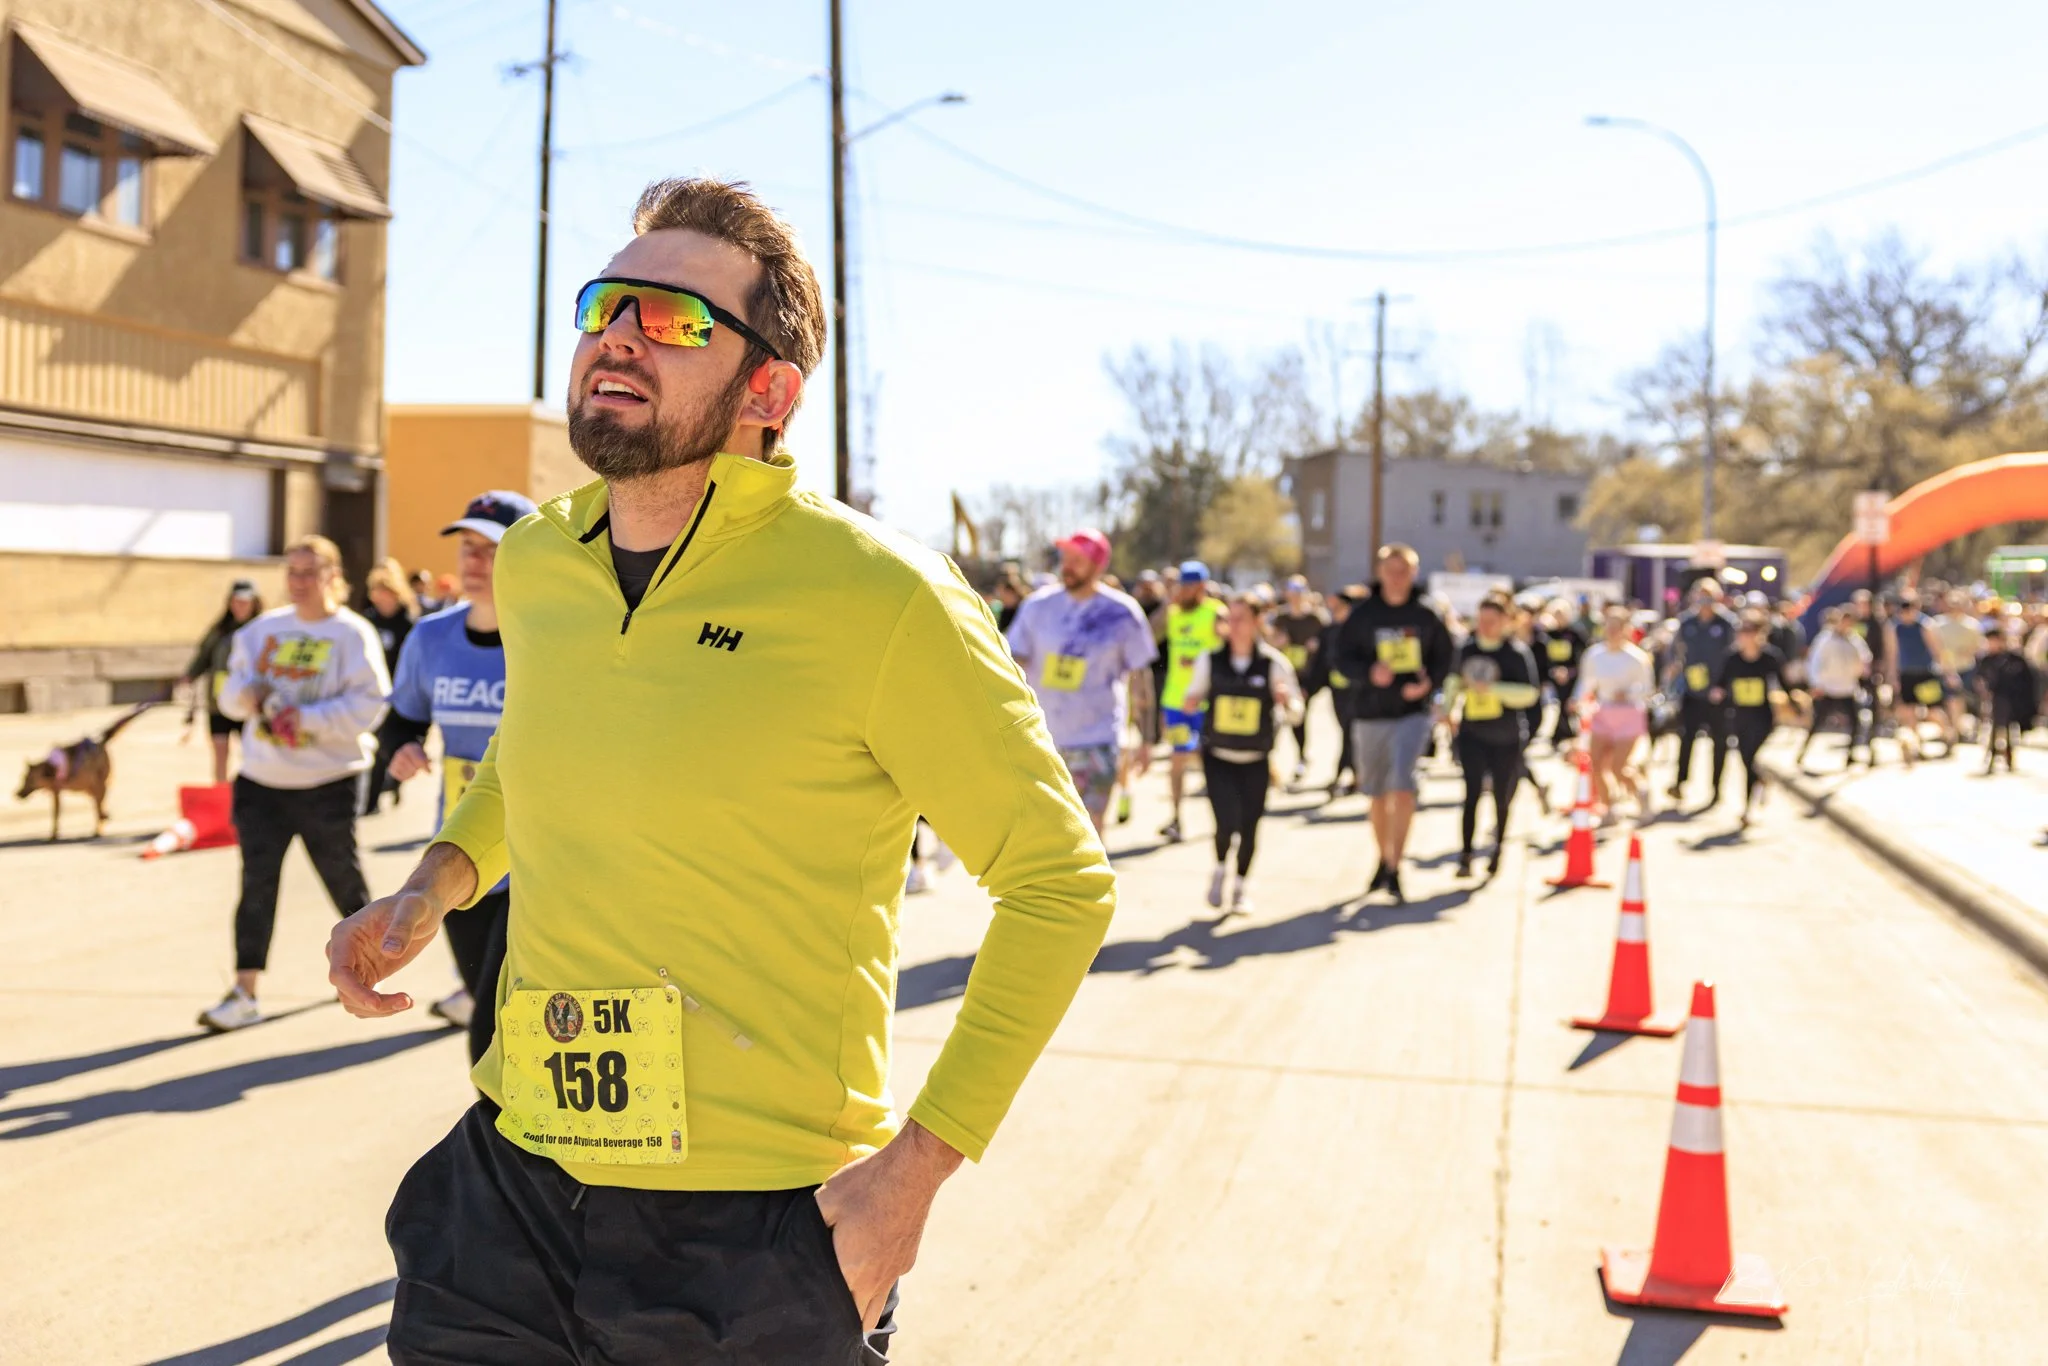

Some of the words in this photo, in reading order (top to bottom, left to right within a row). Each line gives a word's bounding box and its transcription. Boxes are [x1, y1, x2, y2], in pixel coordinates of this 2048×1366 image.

[697, 621, 744, 652] HH
[593, 999, 632, 1034] 5K
[544, 1050, 629, 1113] 158
[523, 1131, 544, 1144] Good
[546, 1134, 556, 1144] for
[558, 1135, 573, 1145] one
[574, 1135, 602, 1147] Atypical
[603, 1137, 643, 1148] Beverage
[646, 1136, 662, 1147] 158
